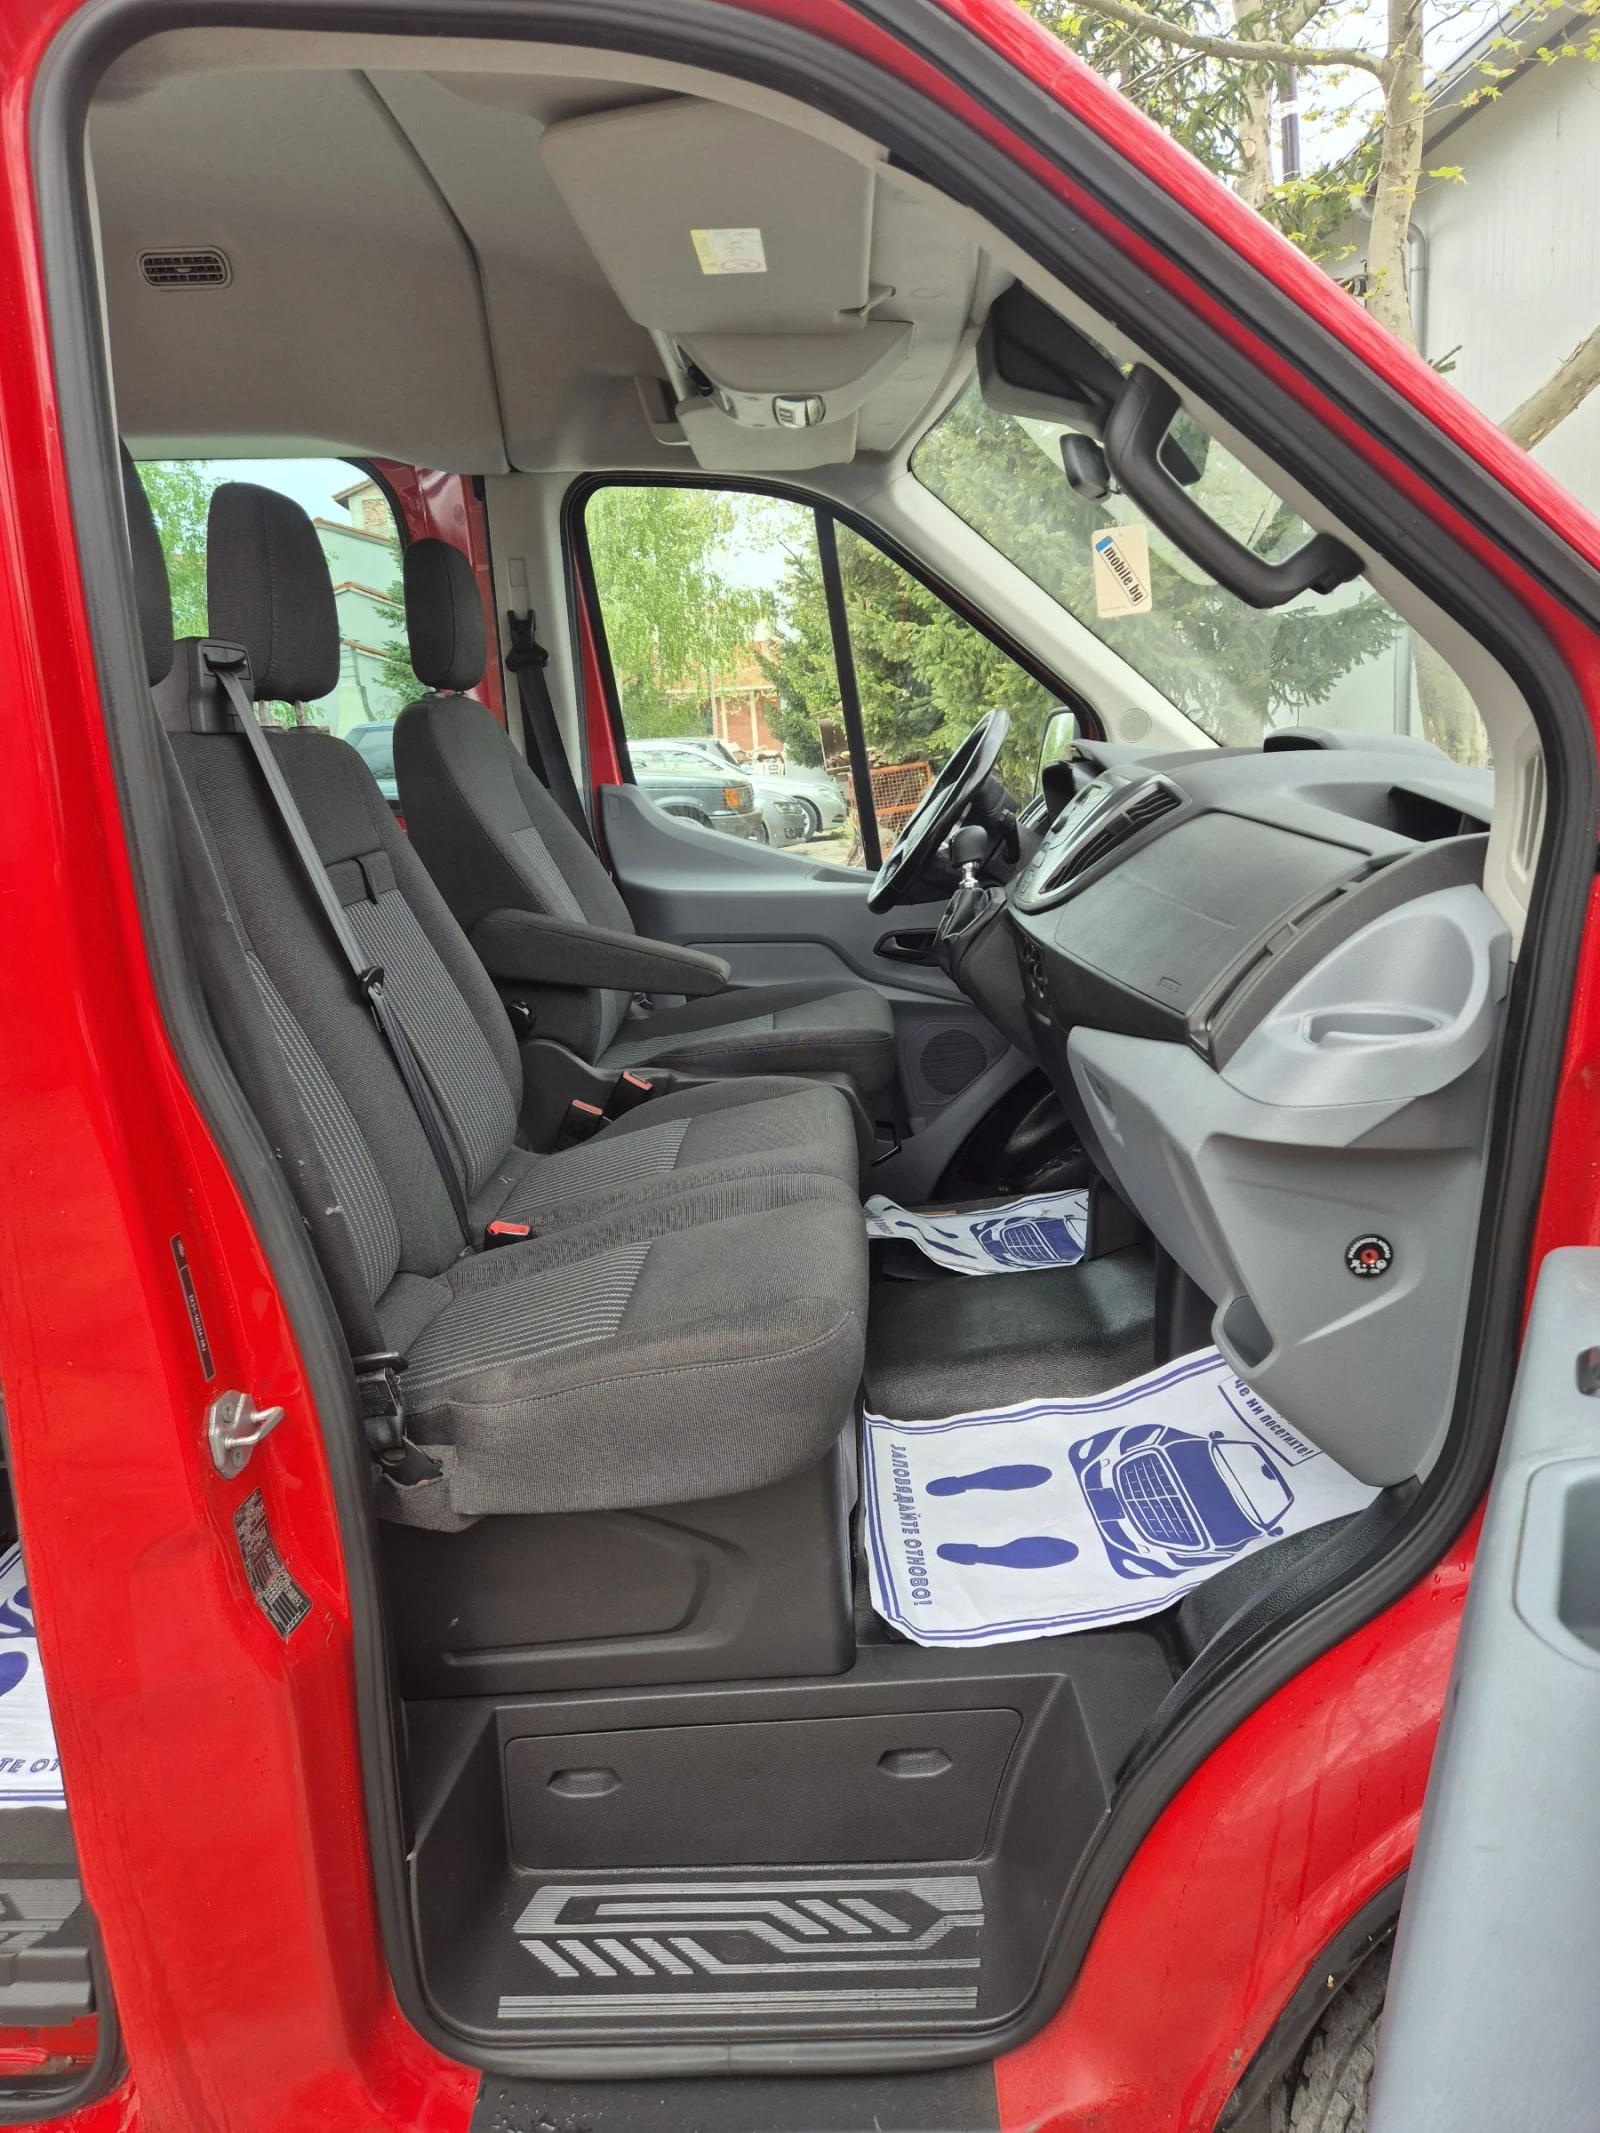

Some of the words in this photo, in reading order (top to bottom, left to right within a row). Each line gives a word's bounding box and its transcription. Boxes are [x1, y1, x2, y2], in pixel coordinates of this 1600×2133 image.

[1104, 547, 1143, 602] mobile.bg
[1348, 1237, 1377, 1258] PASSENGER
[1246, 1398, 1264, 1416] ни
[1259, 1415, 1314, 1457] посетихте!
[890, 1443, 921, 1535] ЗАПОВЯДАЙТЕ
[903, 1538, 932, 1606] ОТНОВО!
